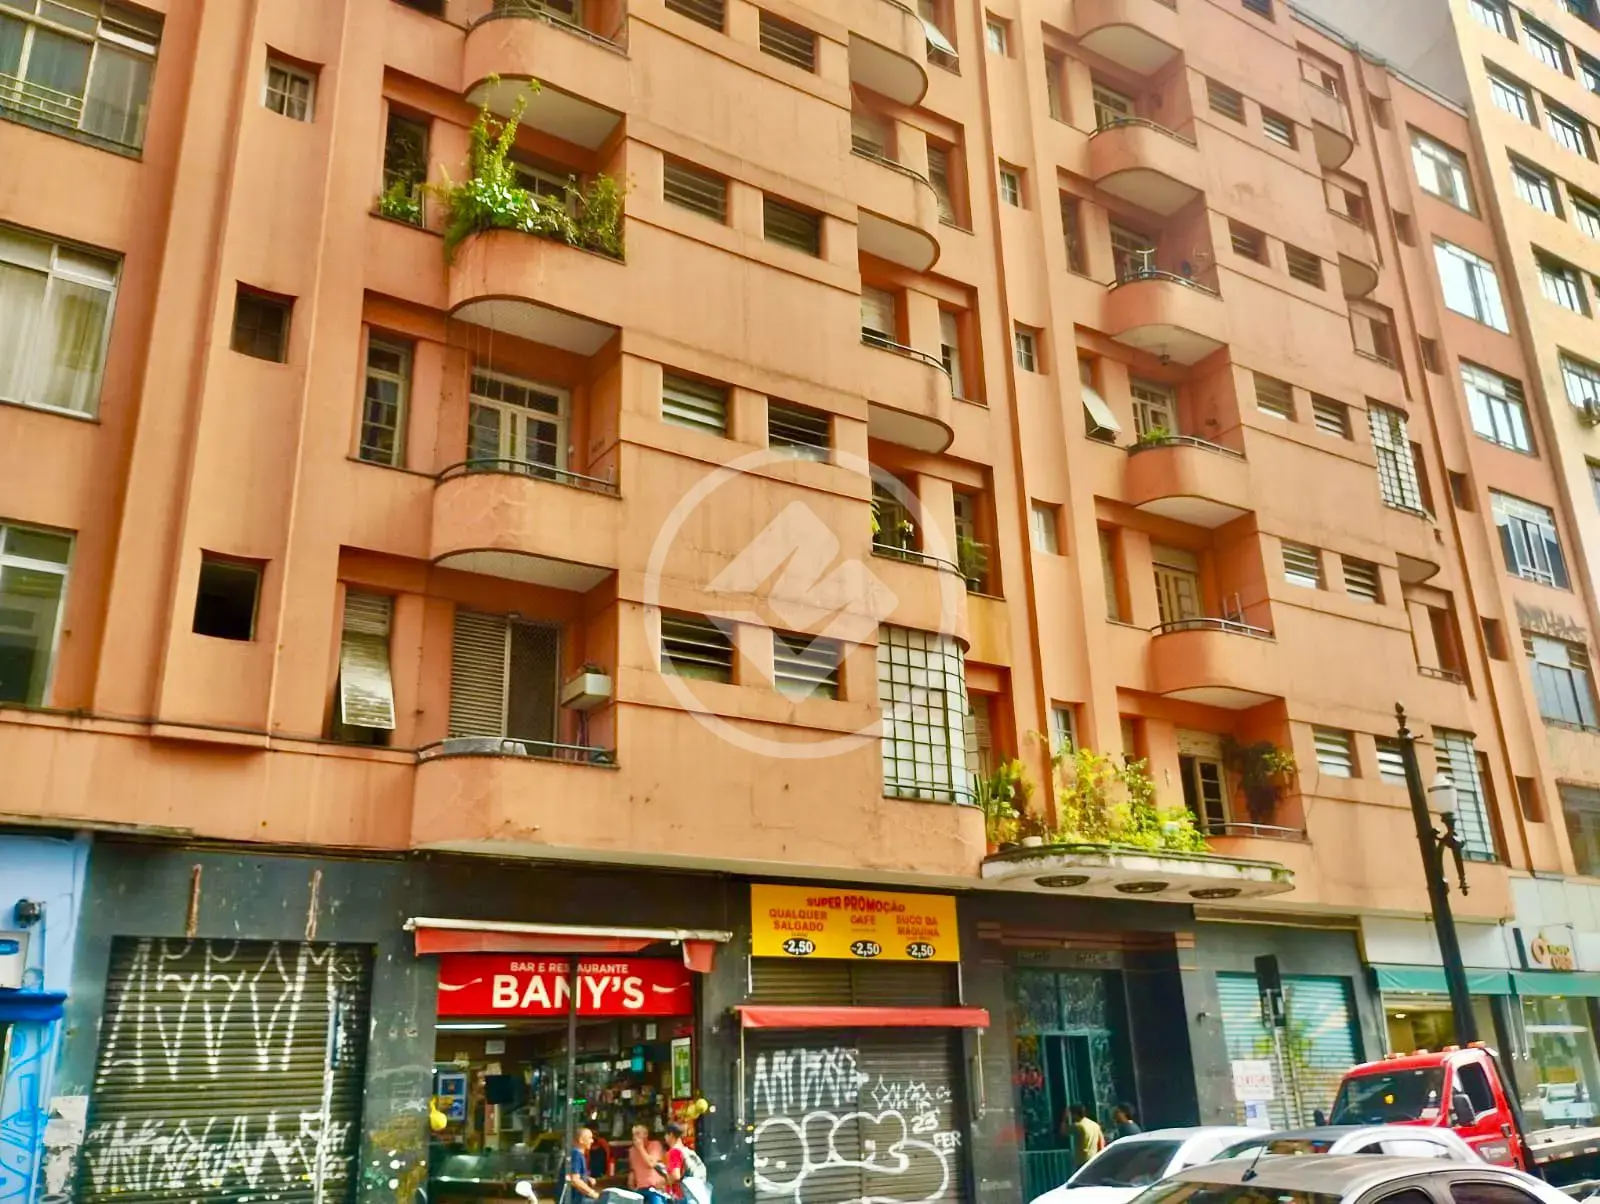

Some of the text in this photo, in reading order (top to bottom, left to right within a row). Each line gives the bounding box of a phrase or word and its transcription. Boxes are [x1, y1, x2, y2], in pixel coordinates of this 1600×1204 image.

[806, 895, 906, 914] SUPER PROMOÇÃO
[769, 908, 828, 921] QUALQUER
[896, 914, 938, 926] SUCO DA
[773, 919, 824, 932] SALGADO
[510, 961, 629, 974] BAR E RESAURANTE
[492, 974, 645, 1009] BANY'S
